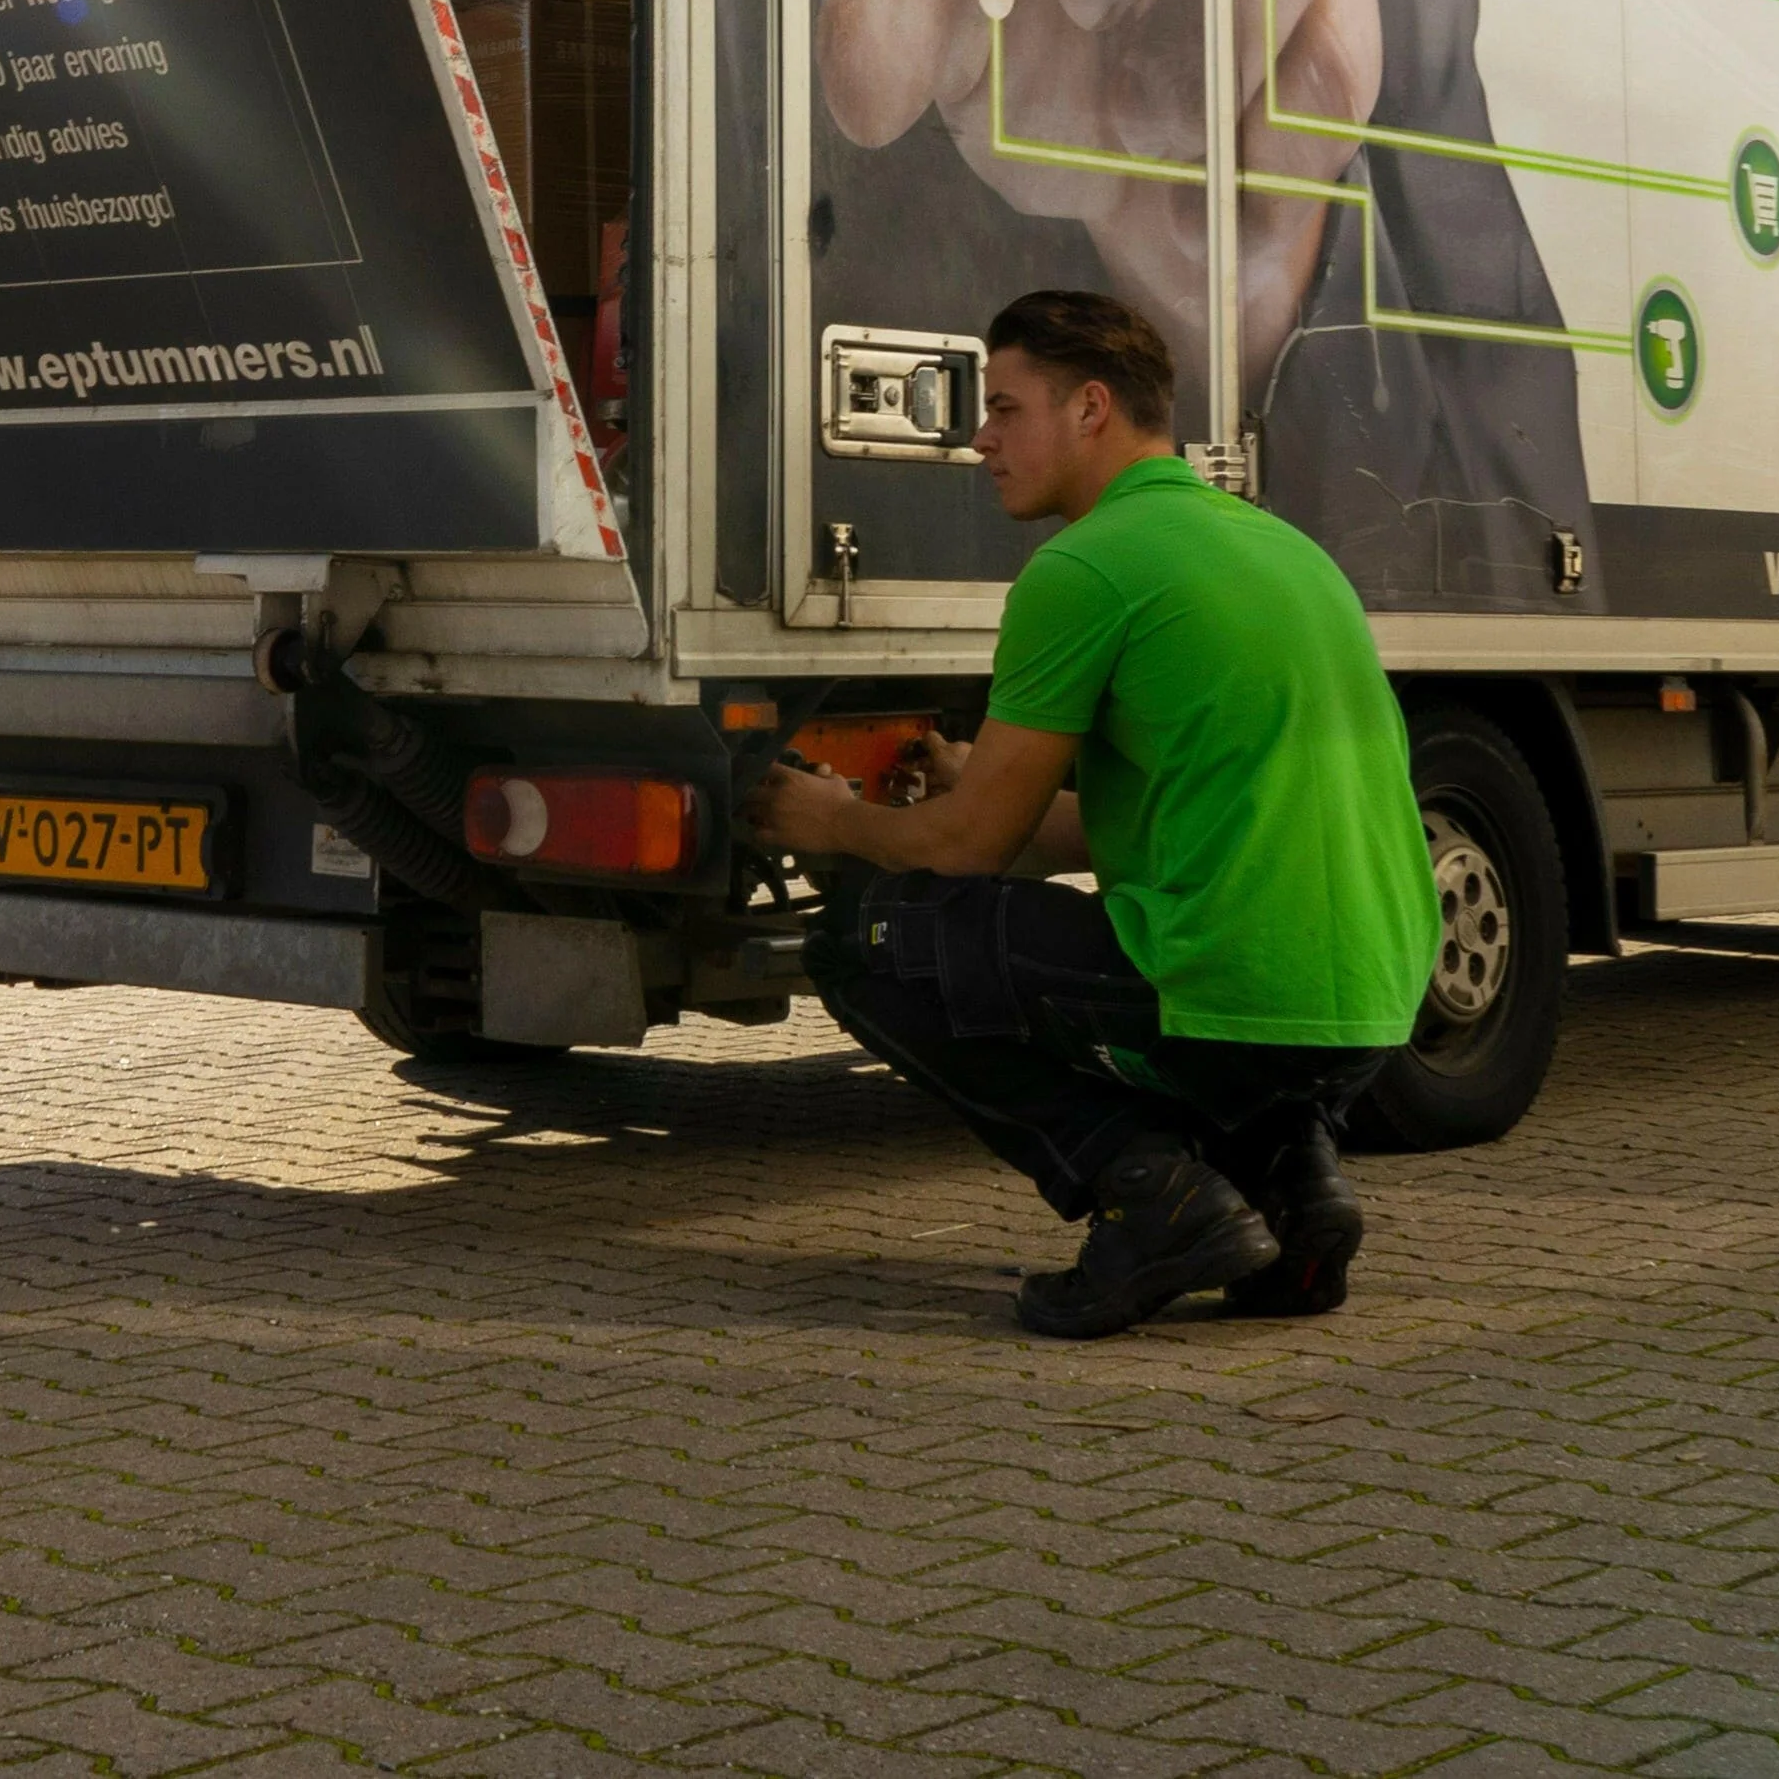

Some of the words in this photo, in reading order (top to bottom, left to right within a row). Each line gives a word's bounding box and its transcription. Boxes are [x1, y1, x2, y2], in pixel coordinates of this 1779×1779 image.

[8, 44, 58, 94] jaar
[63, 35, 169, 79] ervaring
[50, 117, 130, 156] advies
[19, 185, 177, 235] thuisbezorgd
